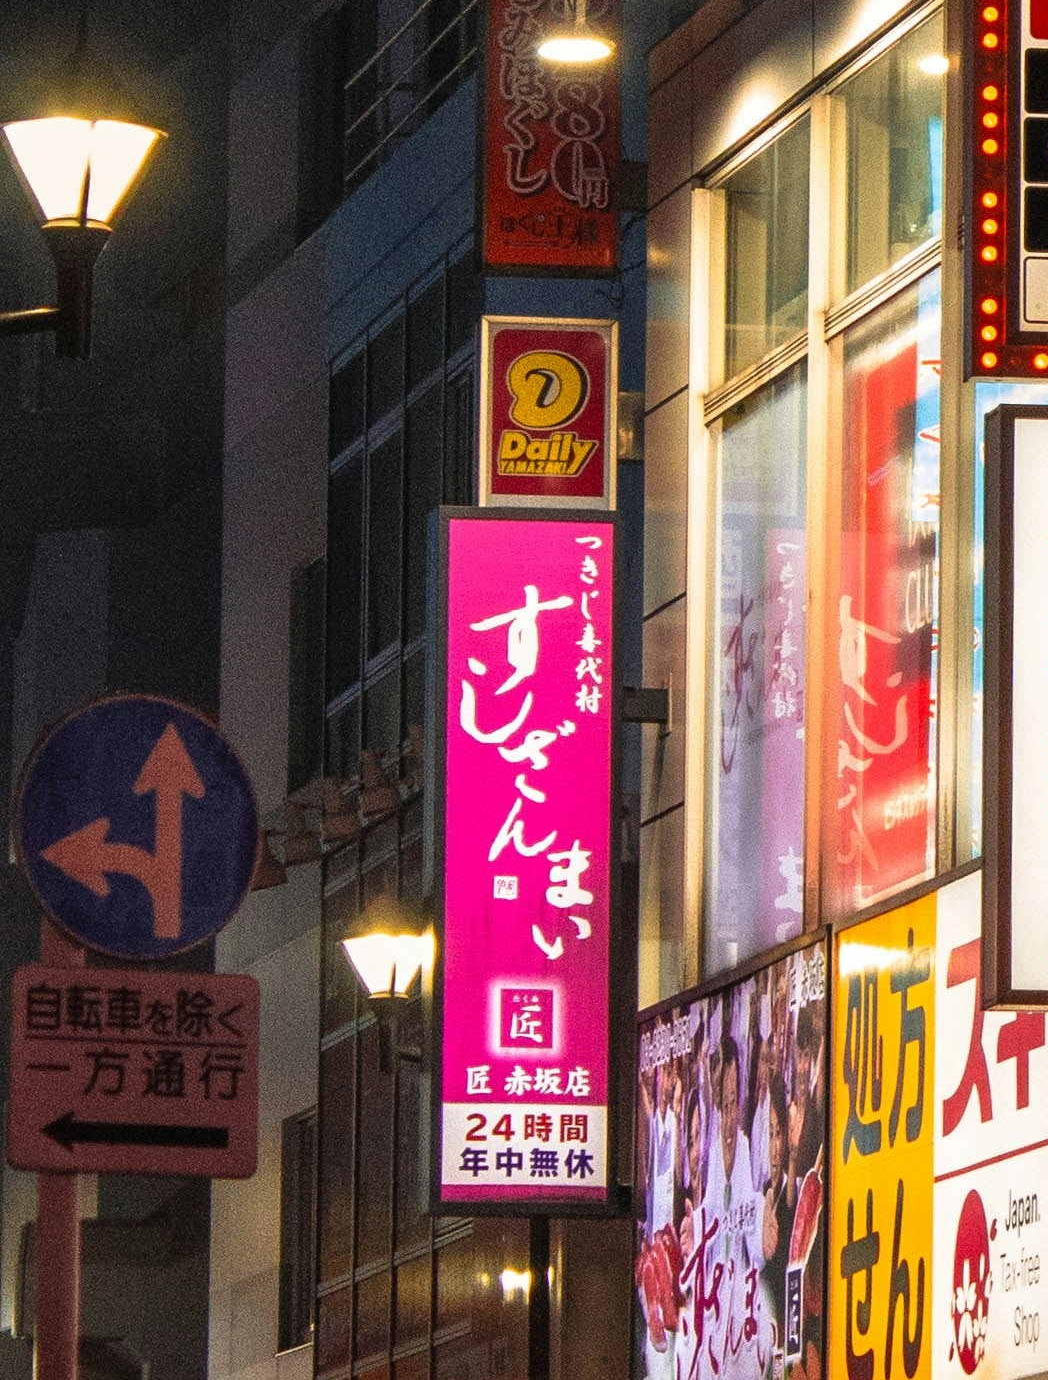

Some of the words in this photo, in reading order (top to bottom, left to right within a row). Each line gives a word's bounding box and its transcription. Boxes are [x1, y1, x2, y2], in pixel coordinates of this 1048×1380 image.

[499, 431, 600, 476] Daily
[499, 459, 570, 475] YAMAZAKI
[460, 584, 595, 961] すしざんまい
[26, 984, 245, 1039] 自転車を除く
[510, 1006, 543, 1043] 匠
[843, 926, 933, 1166] 処方
[25, 1048, 245, 1102] 一方通行
[466, 1066, 492, 1095] 匠
[503, 1066, 592, 1098] 赤坂店
[465, 1113, 590, 1144] 24時間
[459, 1148, 595, 1179] 年中無休
